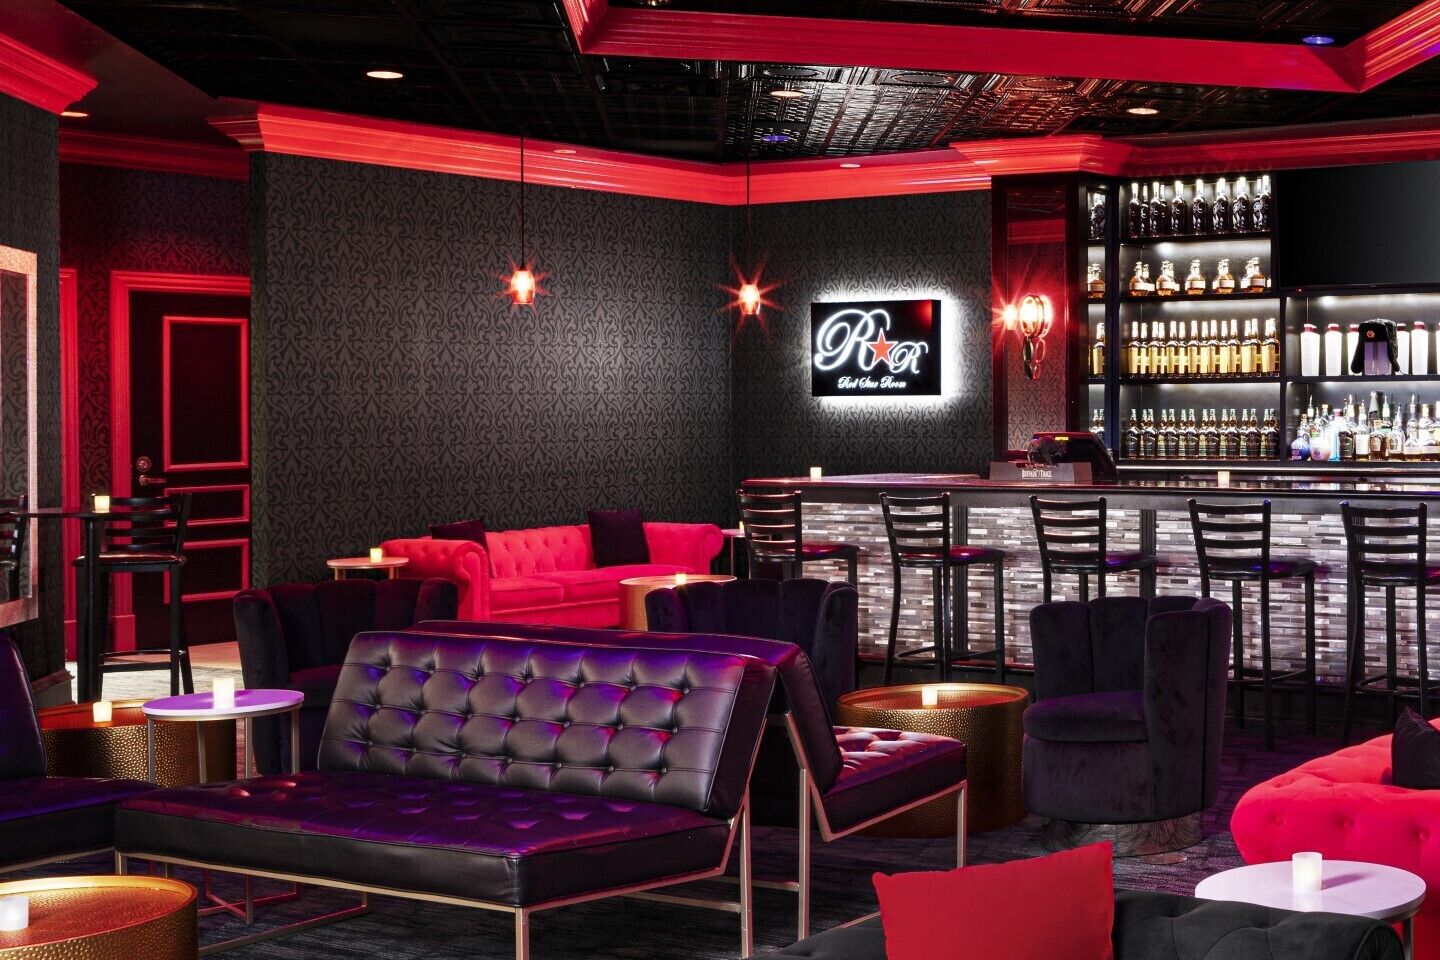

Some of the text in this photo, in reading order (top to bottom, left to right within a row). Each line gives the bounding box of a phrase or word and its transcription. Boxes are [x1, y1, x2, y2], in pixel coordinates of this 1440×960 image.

[838, 376, 906, 390] Red Star Room
